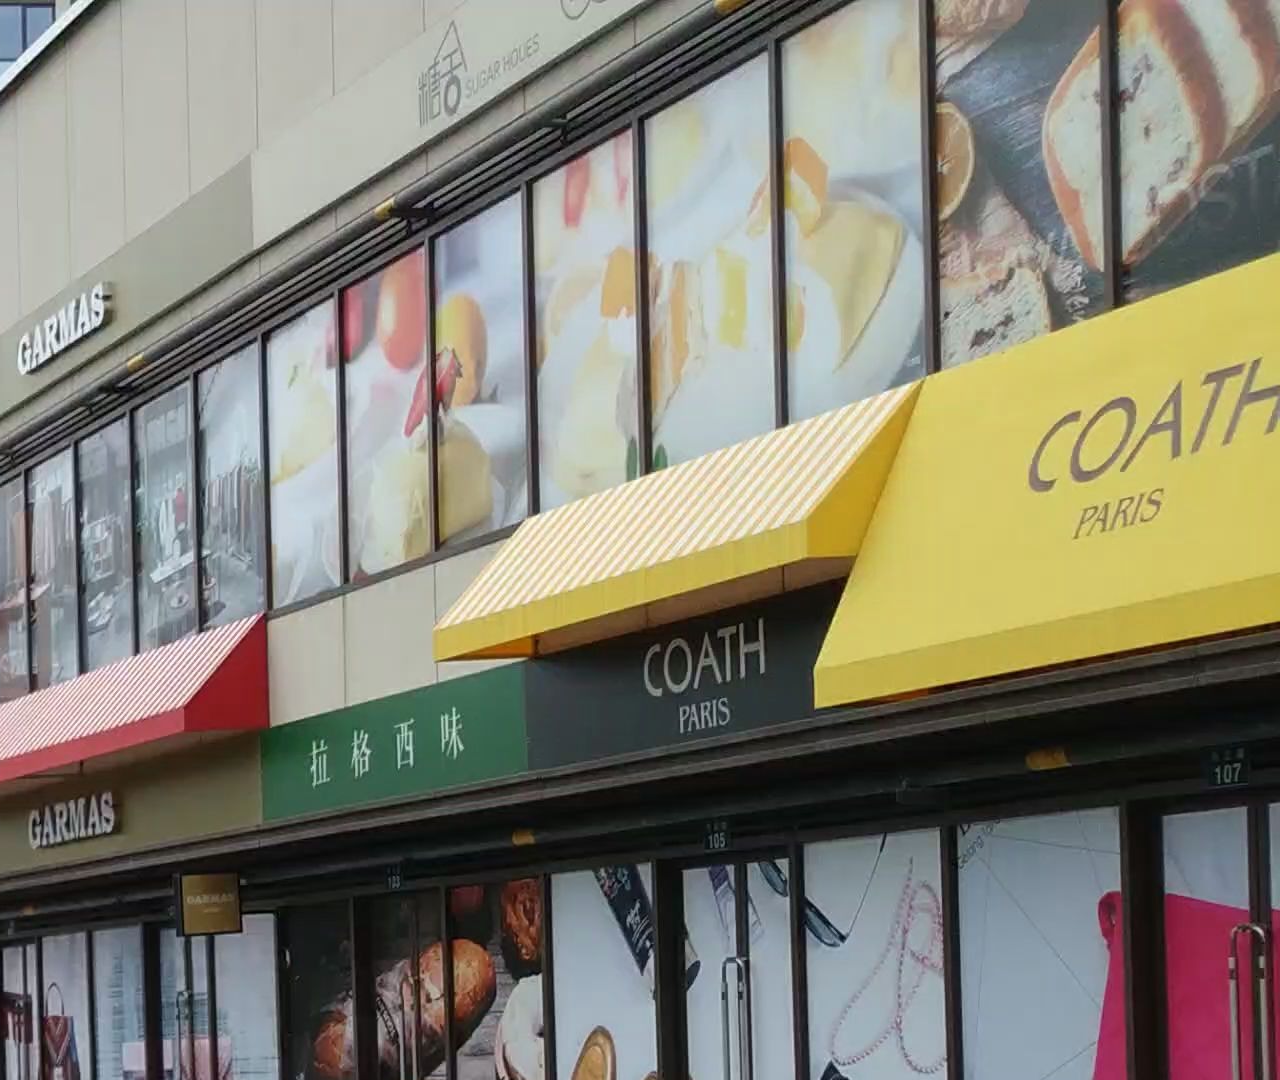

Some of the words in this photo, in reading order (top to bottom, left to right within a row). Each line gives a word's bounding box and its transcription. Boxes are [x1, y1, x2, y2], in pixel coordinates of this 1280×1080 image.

[465, 59, 502, 99] SUGAR
[16, 280, 110, 376] GARMAS
[1028, 356, 1280, 493] COATH
[1072, 486, 1165, 541] PARIS
[642, 616, 767, 698] COATH
[678, 696, 731, 735] PARIS
[308, 705, 465, 789] 拉格西味
[1215, 762, 1242, 785] 107
[27, 791, 117, 850] GARMAS
[708, 832, 726, 849] 105
